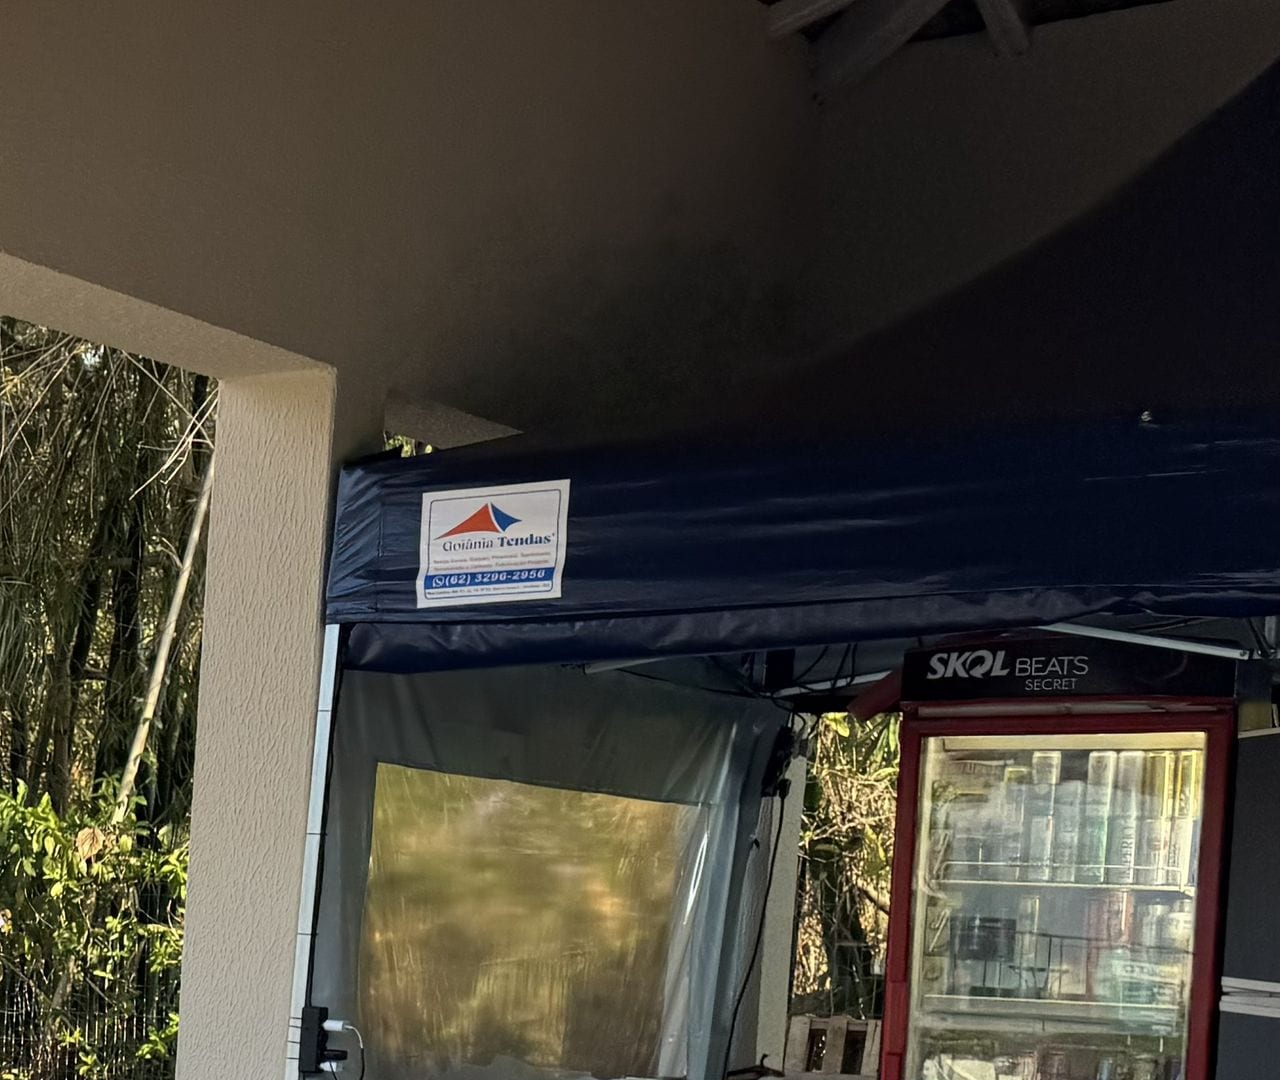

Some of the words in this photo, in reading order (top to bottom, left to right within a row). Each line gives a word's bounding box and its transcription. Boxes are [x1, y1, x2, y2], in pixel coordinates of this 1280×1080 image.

[497, 533, 551, 548] Tendas
[445, 573, 471, 587] (62)
[926, 649, 1010, 679] SKOL
[1015, 656, 1089, 676] BEATS
[1025, 678, 1078, 691] SECRET
